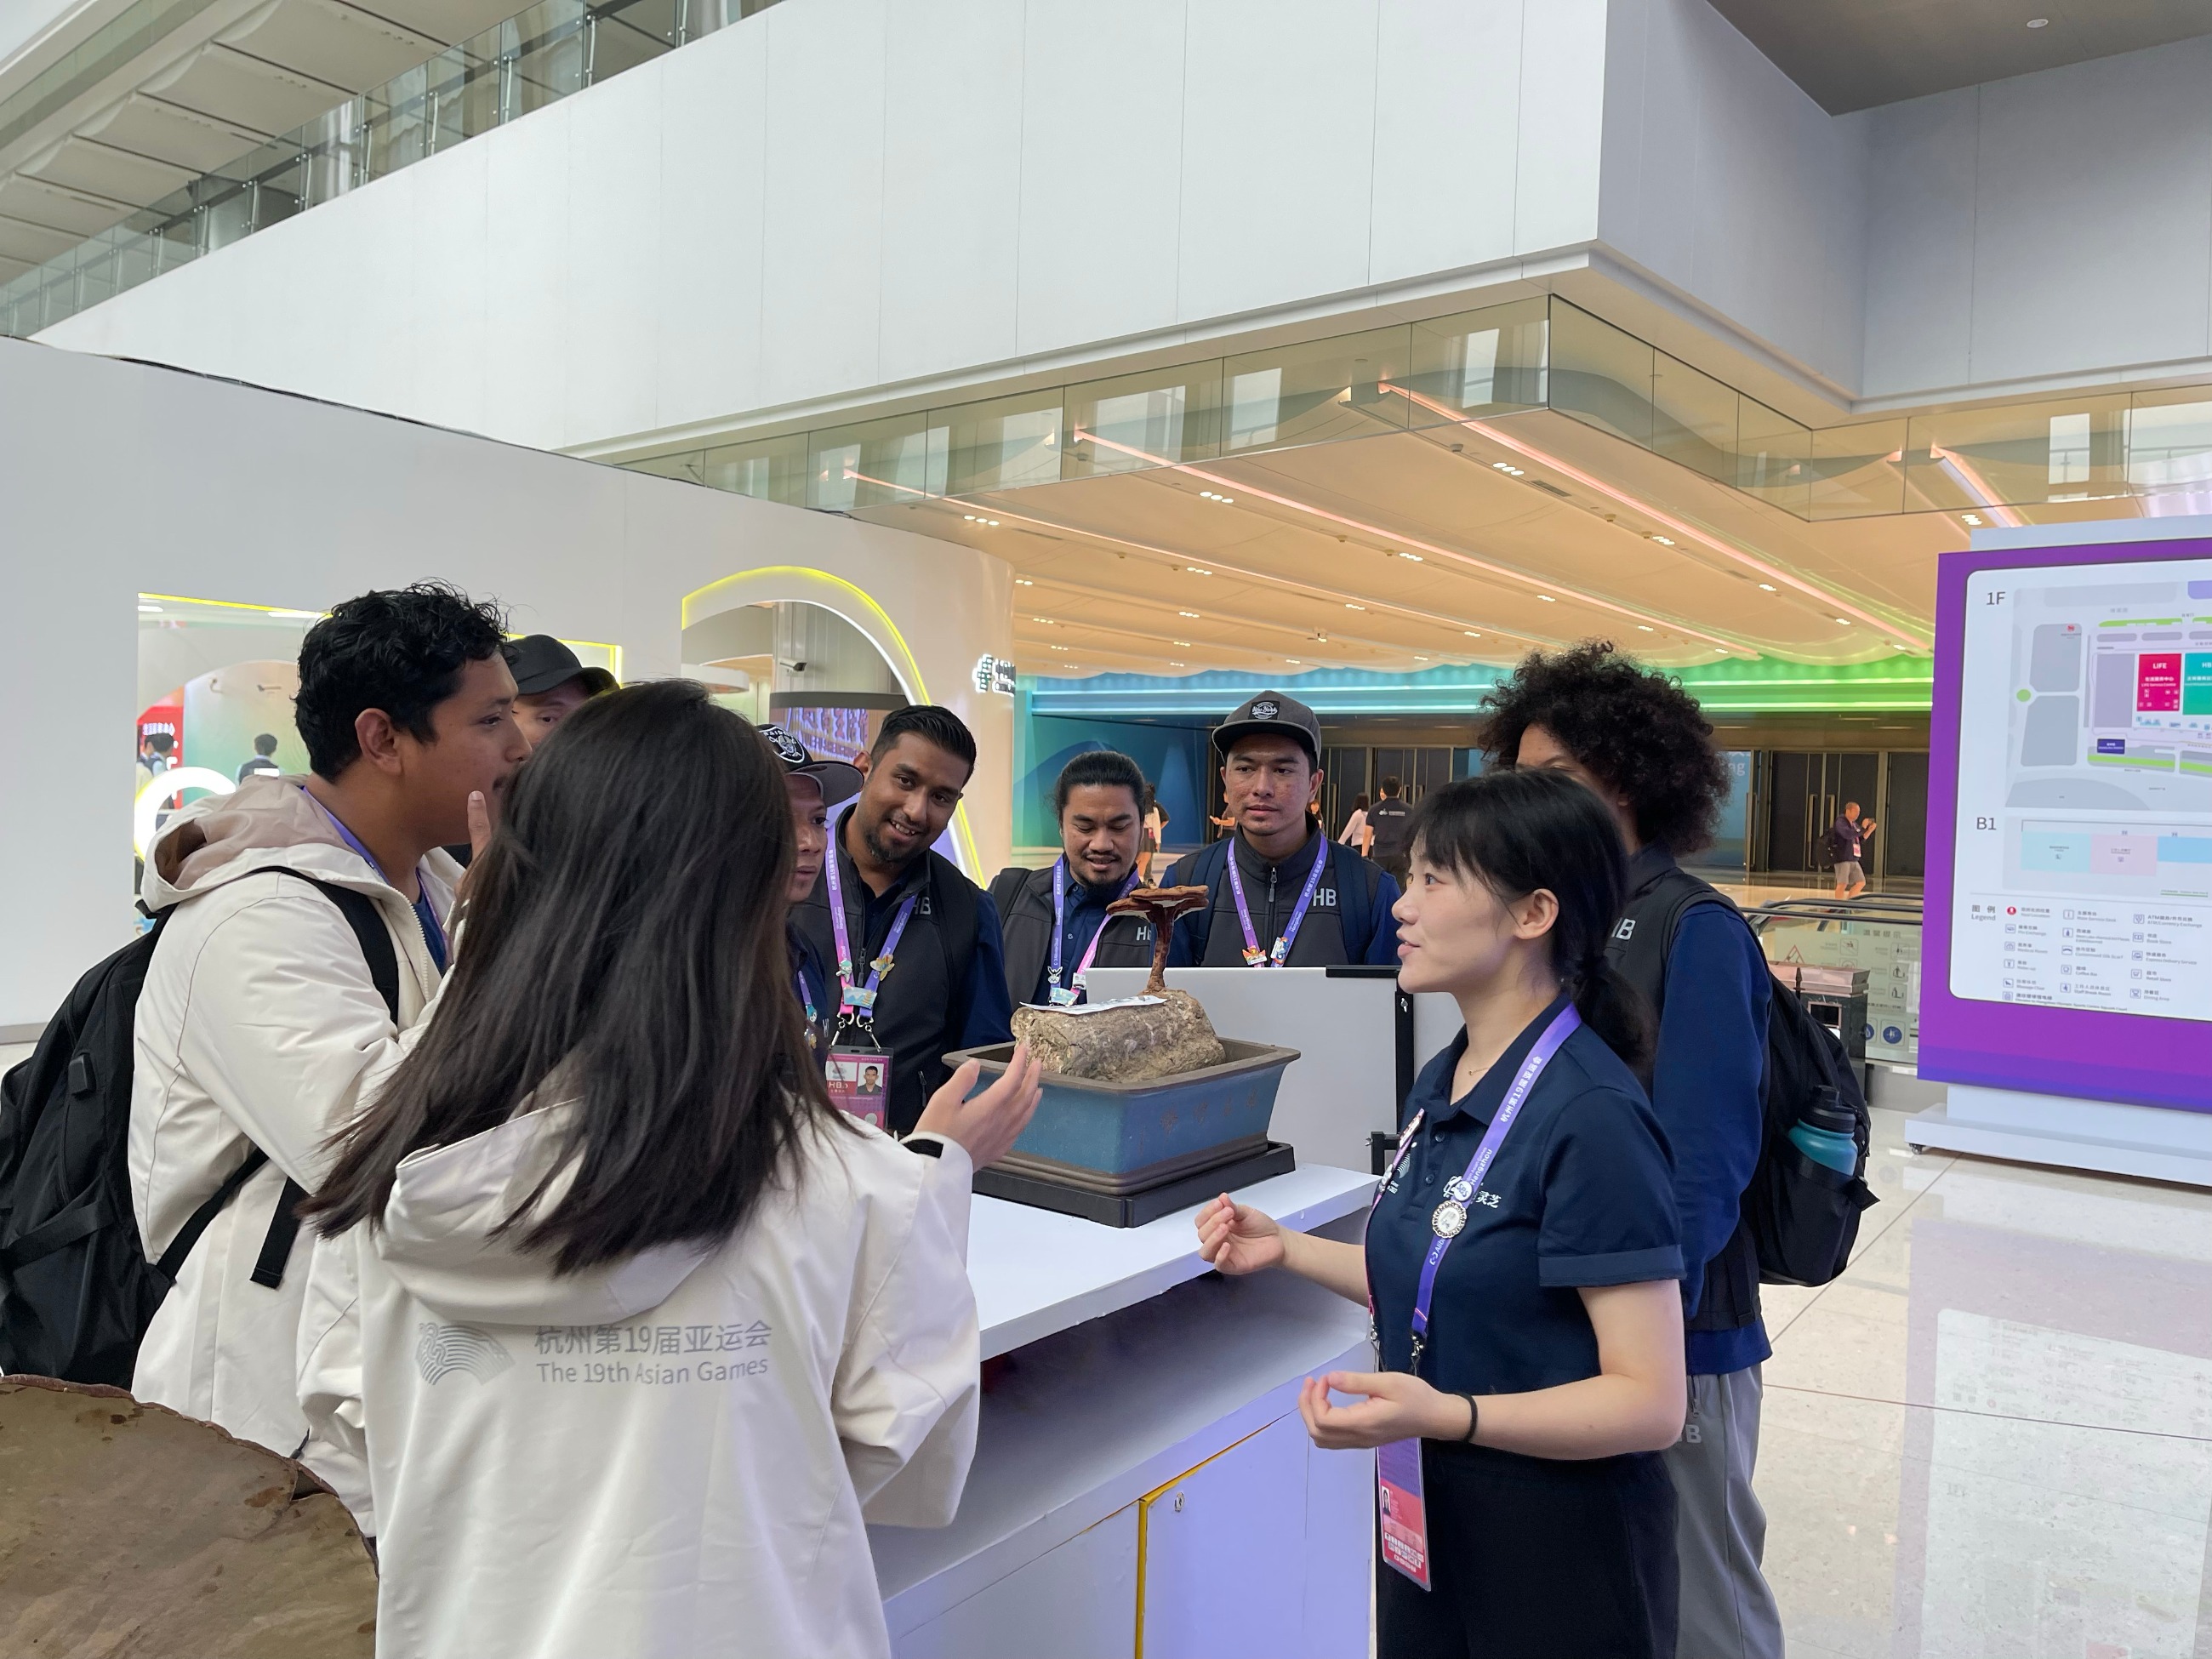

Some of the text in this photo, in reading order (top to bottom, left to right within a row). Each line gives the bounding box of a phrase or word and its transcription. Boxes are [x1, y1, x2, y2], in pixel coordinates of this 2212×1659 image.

[1986, 592, 2005, 605] 1F
[1976, 818, 1997, 830] B1
[1313, 888, 1337, 907] HB
[1500, 1056, 1542, 1122] 杭州第19届亚运会
[1470, 1149, 1493, 1186] Hangzhou
[534, 1320, 772, 1356] 杭州第19届亚运会
[536, 1358, 768, 1385] The 19th Asian Games
